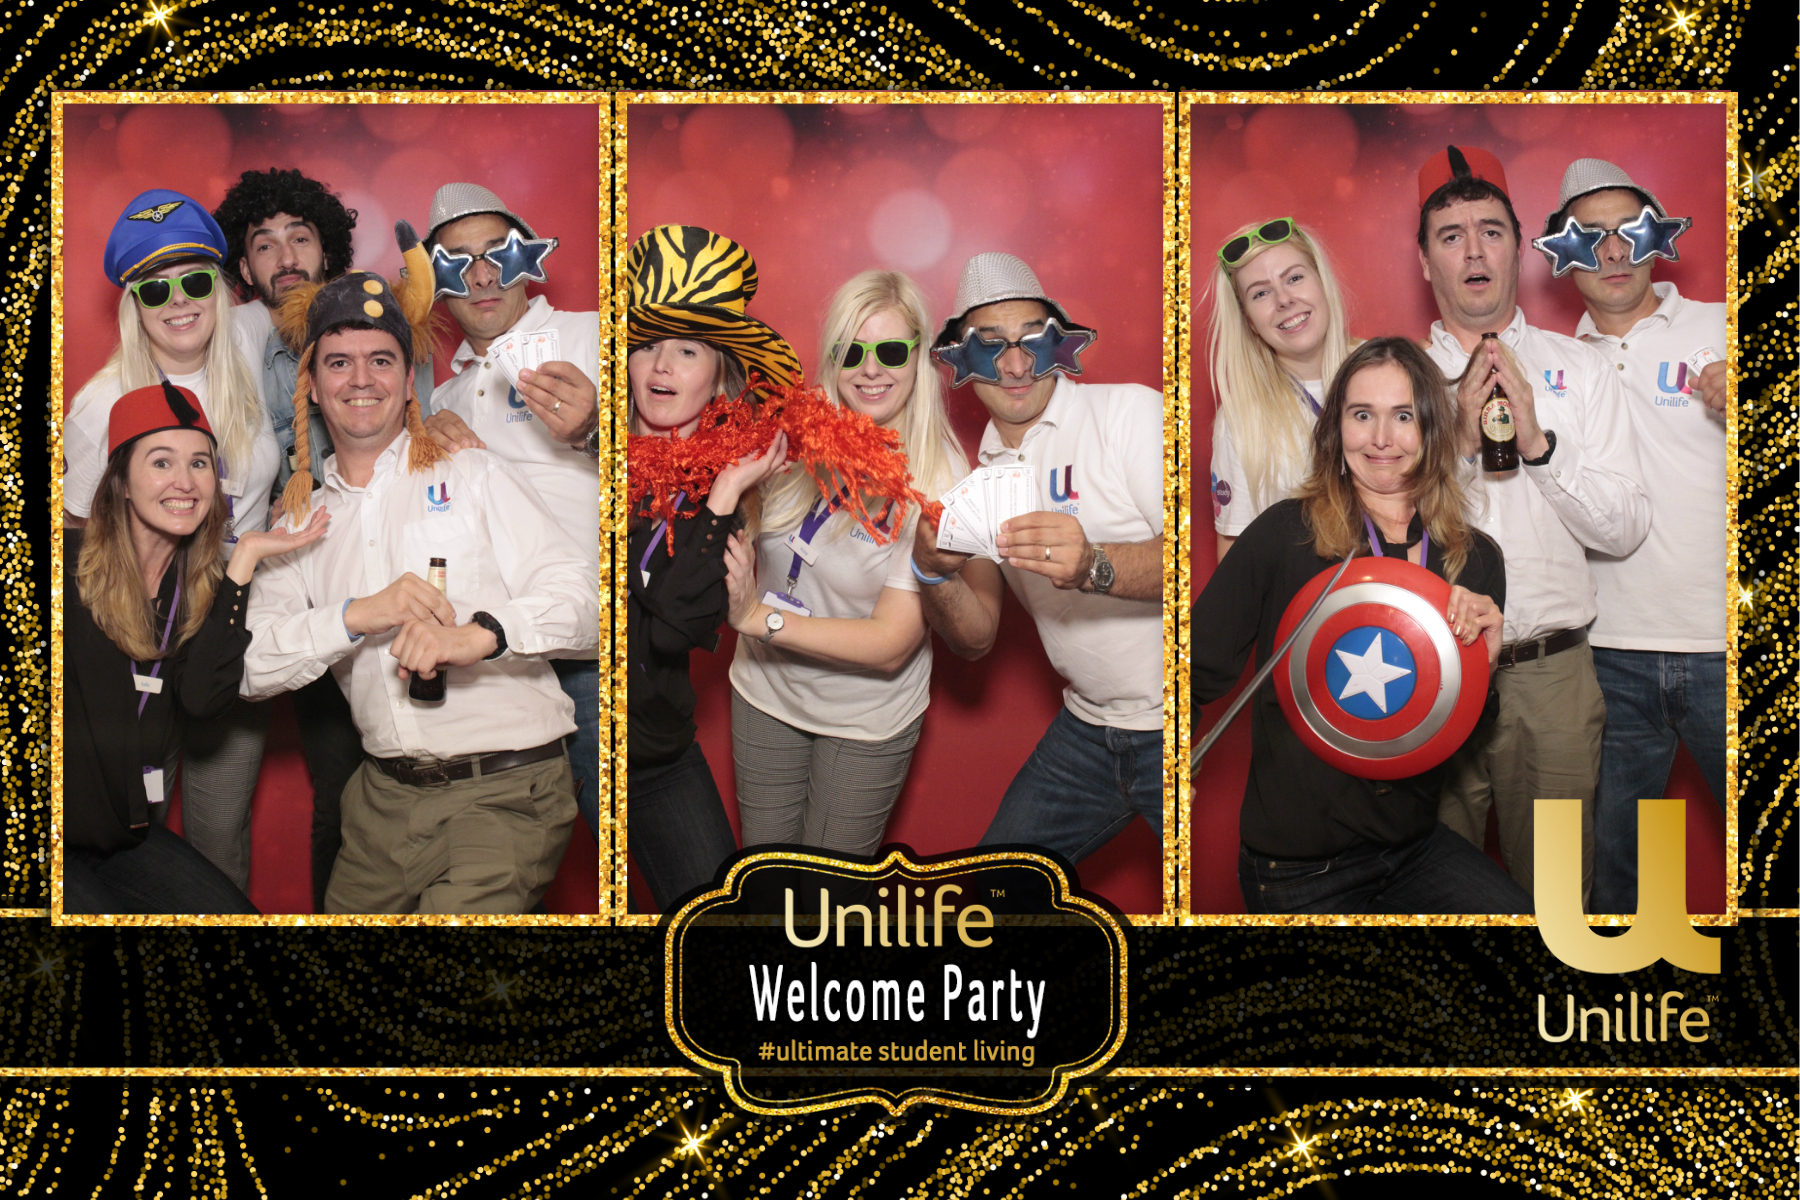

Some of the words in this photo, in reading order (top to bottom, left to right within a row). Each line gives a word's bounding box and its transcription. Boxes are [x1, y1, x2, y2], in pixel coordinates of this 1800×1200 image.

[1655, 395, 1689, 407] Unilife
[506, 410, 533, 423] Unilife
[849, 527, 875, 544] Unili
